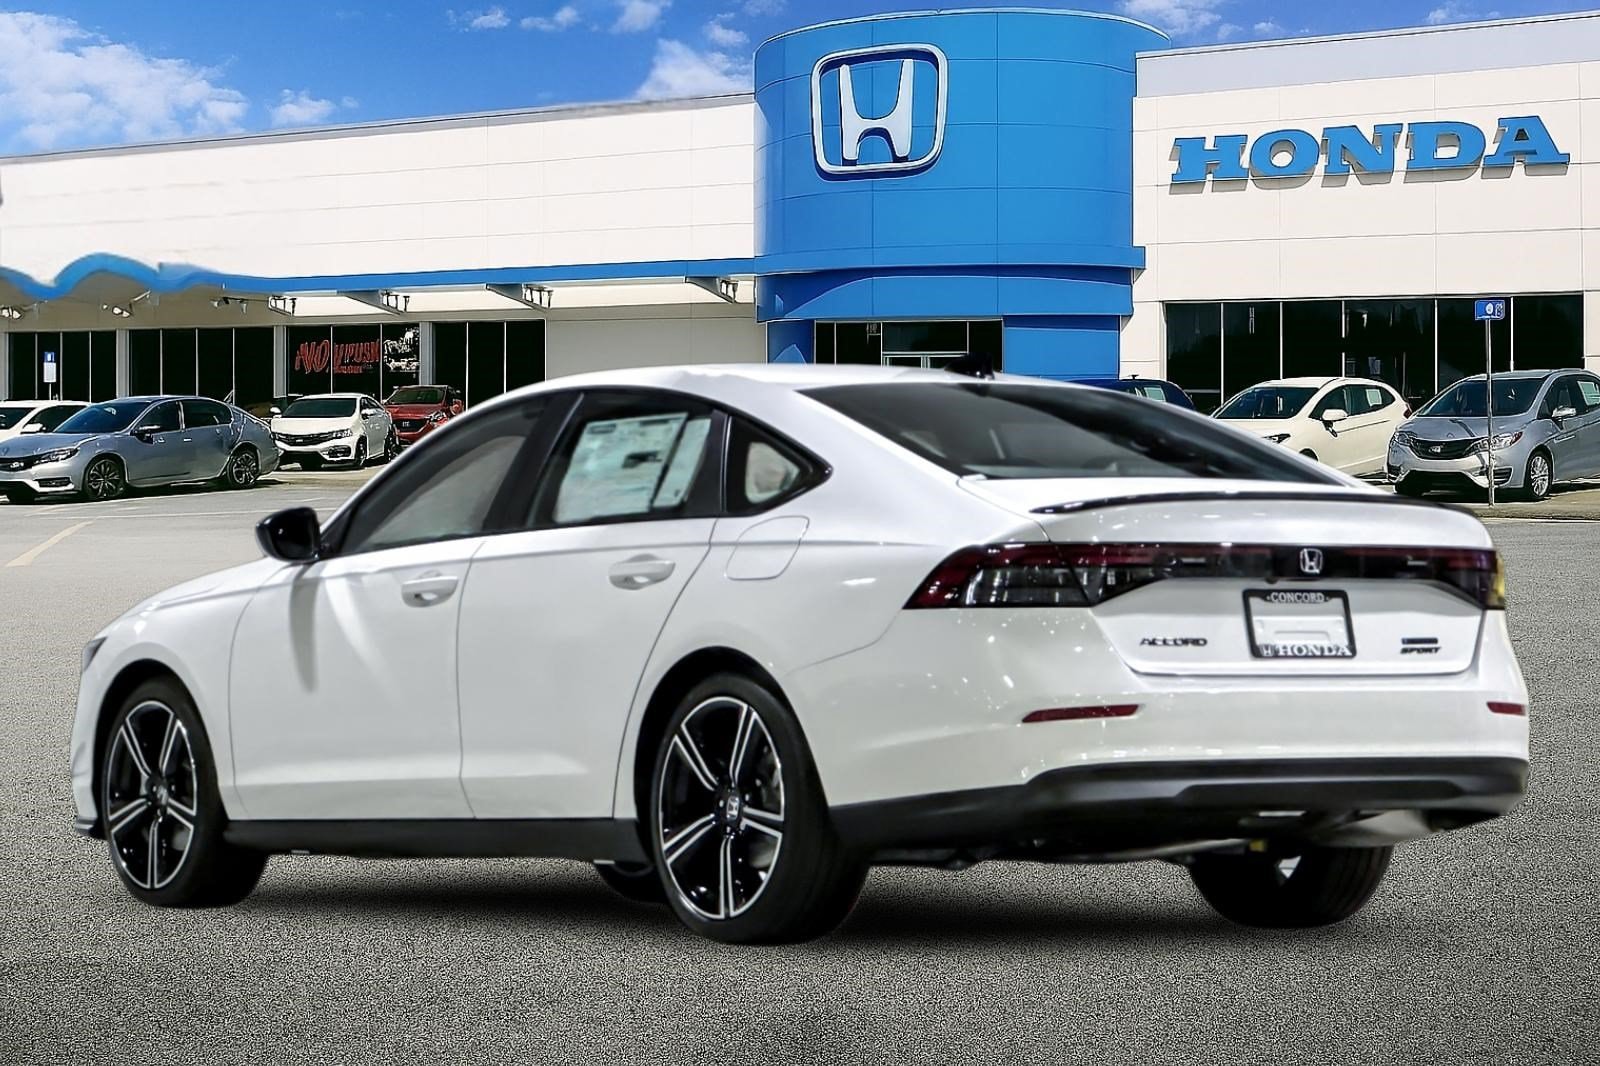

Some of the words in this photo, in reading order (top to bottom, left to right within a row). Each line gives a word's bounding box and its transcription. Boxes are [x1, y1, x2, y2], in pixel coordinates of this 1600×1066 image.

[1171, 115, 1570, 184] HONDA
[1270, 592, 1325, 603] CONCORD
[1139, 637, 1208, 647] ACCORD
[1278, 643, 1352, 656] HONDA
